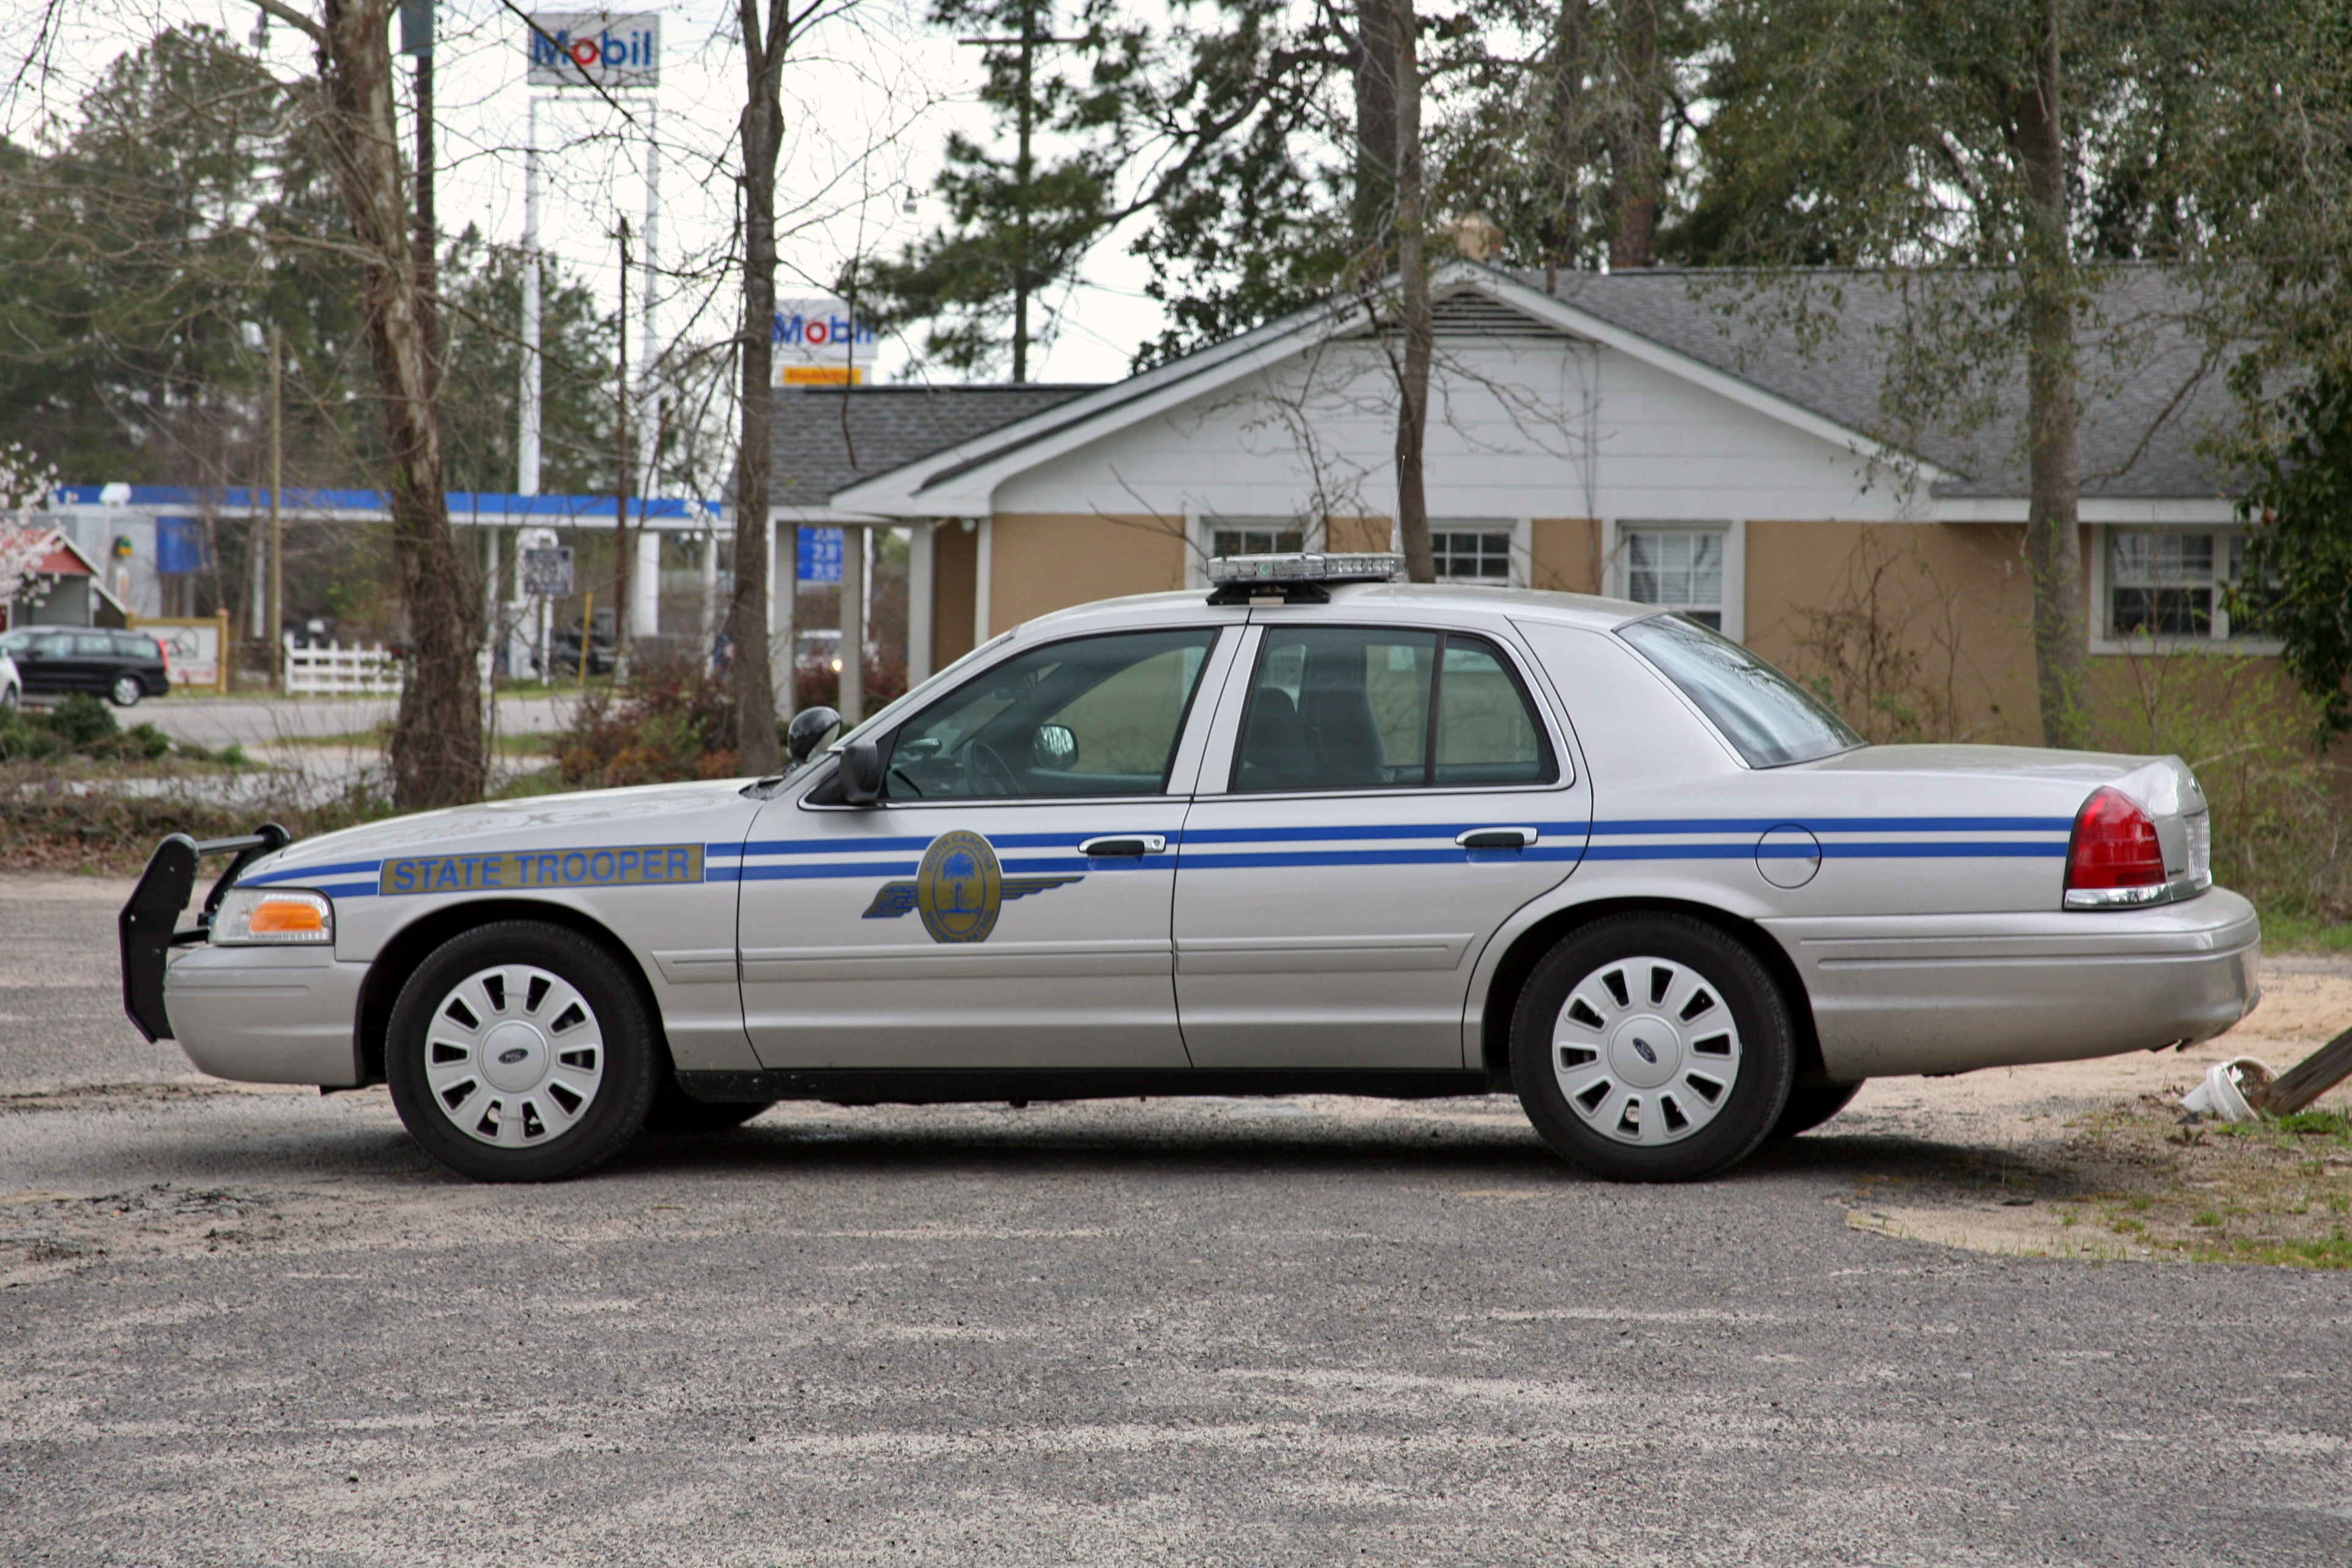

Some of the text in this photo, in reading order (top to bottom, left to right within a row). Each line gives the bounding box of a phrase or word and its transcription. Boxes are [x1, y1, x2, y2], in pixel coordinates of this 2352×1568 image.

[534, 29, 651, 65] Mobil
[394, 848, 690, 891] STATE TROOPER
[925, 834, 994, 872] SOUTH CAROLINA
